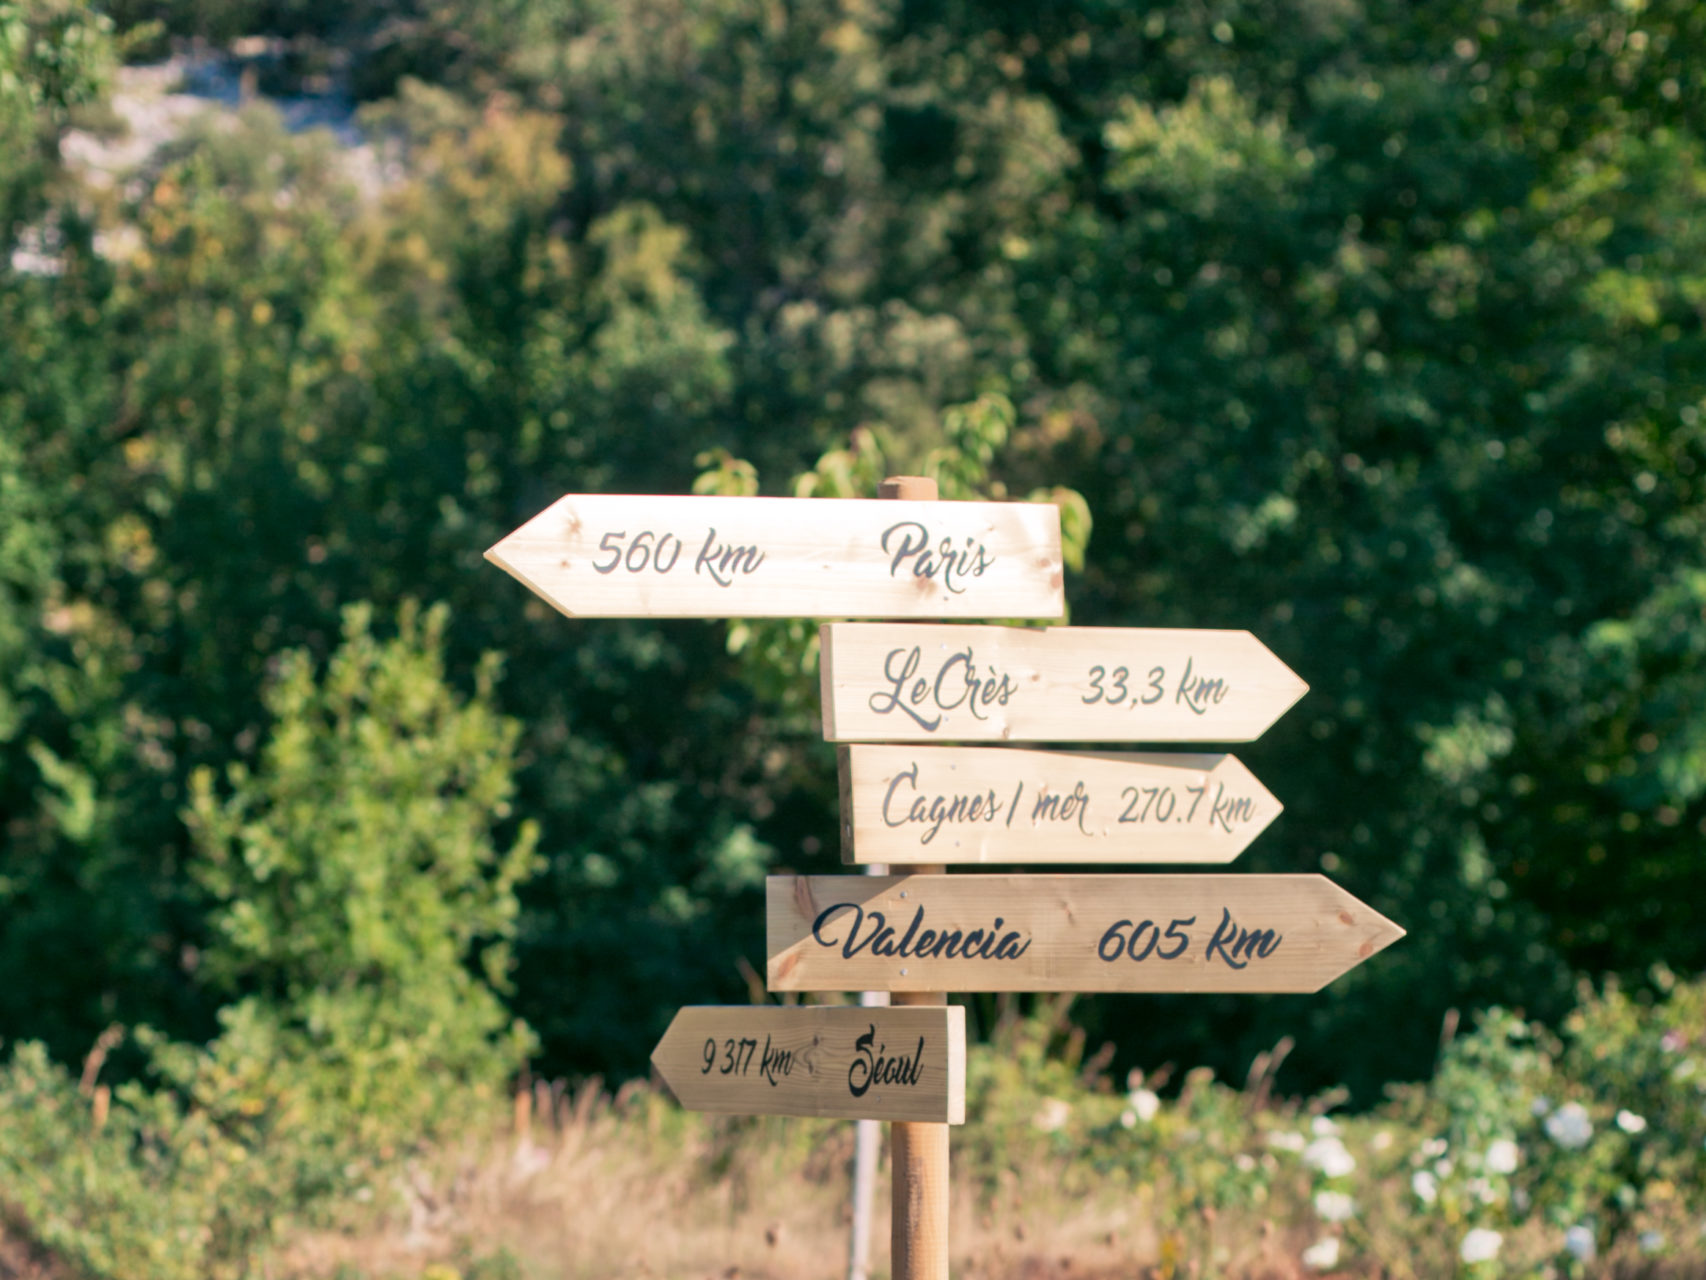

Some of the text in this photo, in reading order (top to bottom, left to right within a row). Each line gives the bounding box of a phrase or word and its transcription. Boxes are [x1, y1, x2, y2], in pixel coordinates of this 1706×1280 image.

[593, 521, 996, 594] 560 km Paris
[1081, 665, 1165, 709] 33,3
[1176, 656, 1229, 715] km
[881, 762, 1002, 844] Cagnes
[1031, 780, 1094, 837] mer
[1117, 787, 1205, 824] 270.7
[1209, 781, 1256, 833] km
[812, 903, 1283, 970] Valencia 605 km
[759, 1033, 794, 1087] km
[848, 1023, 924, 1097] Séoul
